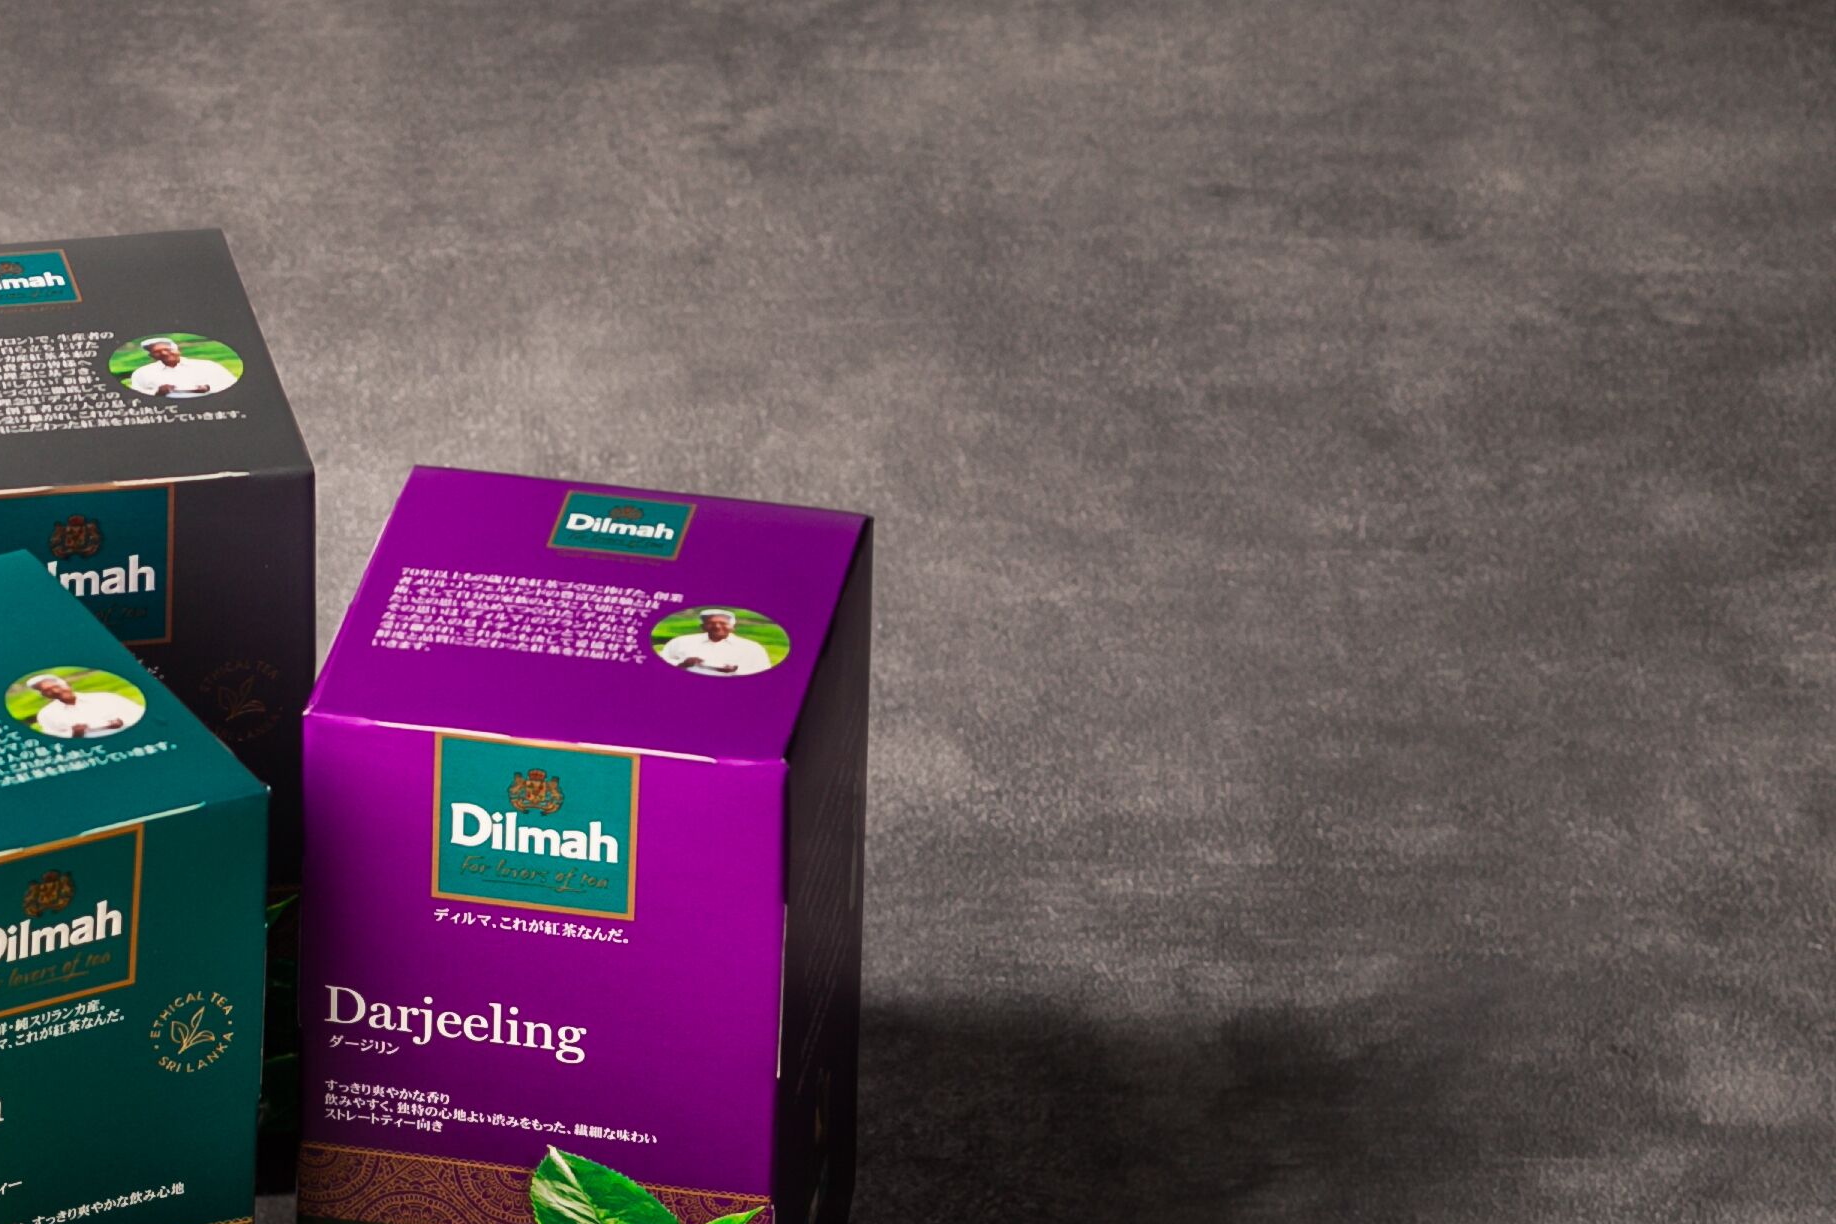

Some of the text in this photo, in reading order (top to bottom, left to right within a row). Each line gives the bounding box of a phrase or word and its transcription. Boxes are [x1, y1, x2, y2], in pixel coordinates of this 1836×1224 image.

[565, 512, 675, 542] Dilmah
[449, 802, 619, 864] Dilmah
[461, 855, 491, 876] For
[579, 875, 608, 891] tea
[433, 906, 630, 945] ディルマ、これが紅茶なんだ。
[150, 990, 234, 1038] ETHICAL TEA
[324, 984, 588, 1065] Darjeeling
[158, 1031, 234, 1073] SRI LANKA
[328, 1034, 401, 1056] ダージリン
[324, 1079, 451, 1106] すっきり爽やかな香り
[324, 1106, 444, 1134] ストレートティー向き
